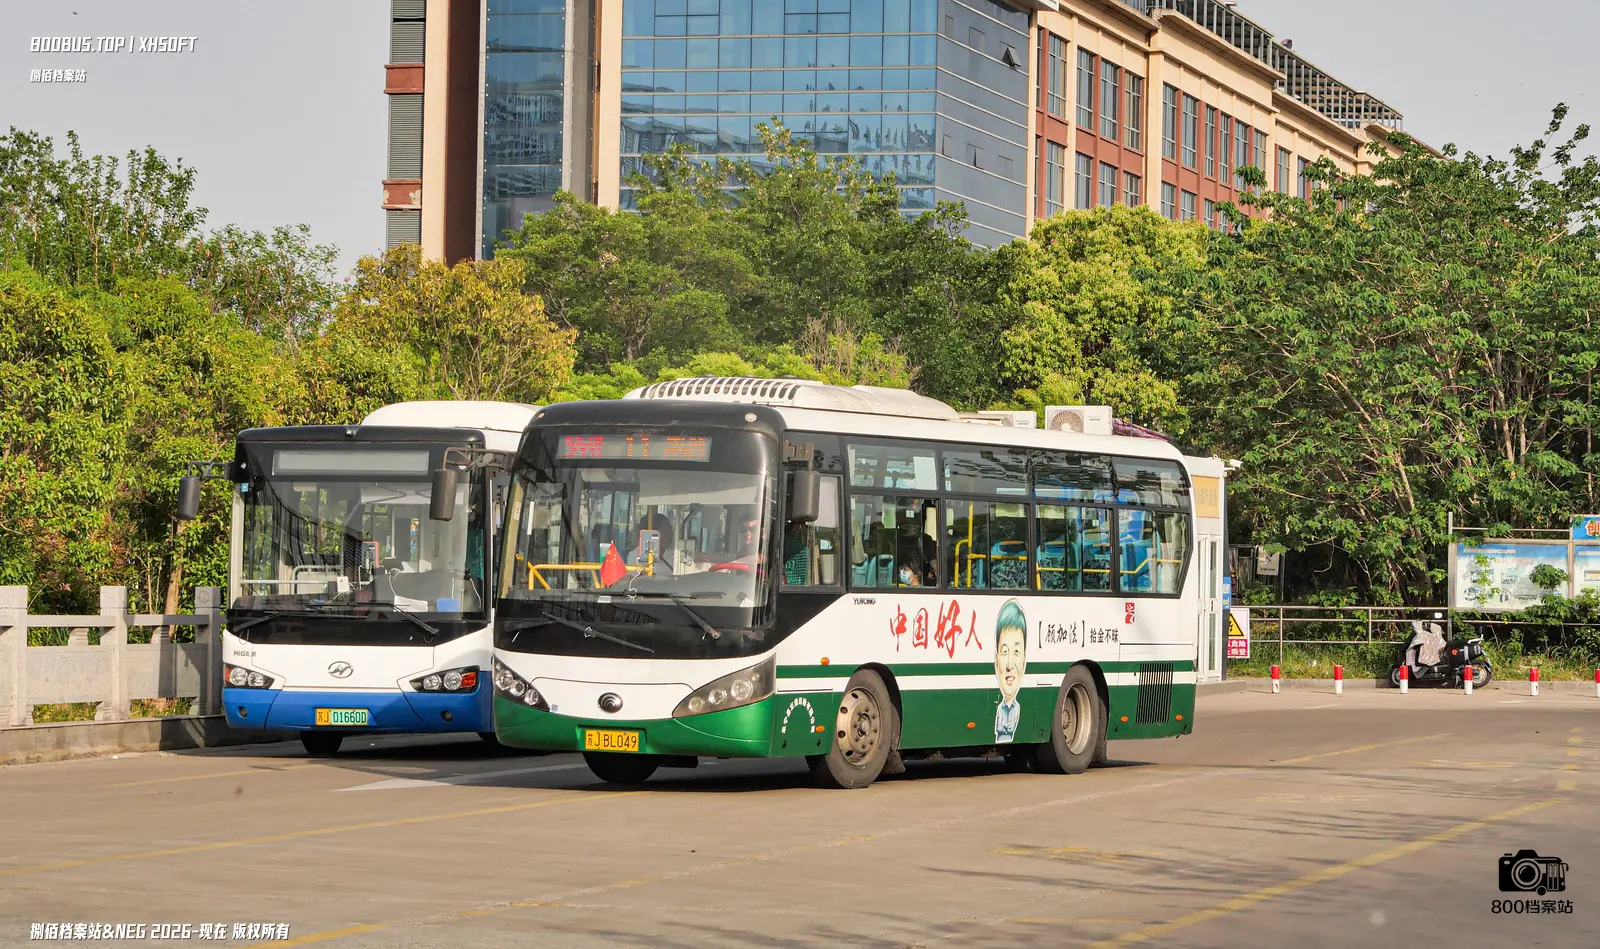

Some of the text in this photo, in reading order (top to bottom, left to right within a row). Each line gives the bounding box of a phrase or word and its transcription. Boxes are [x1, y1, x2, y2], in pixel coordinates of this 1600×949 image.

[889, 598, 983, 659] 中国好人
[1090, 627, 1119, 644] 拾金不昧
[233, 650, 257, 658] HIGER
